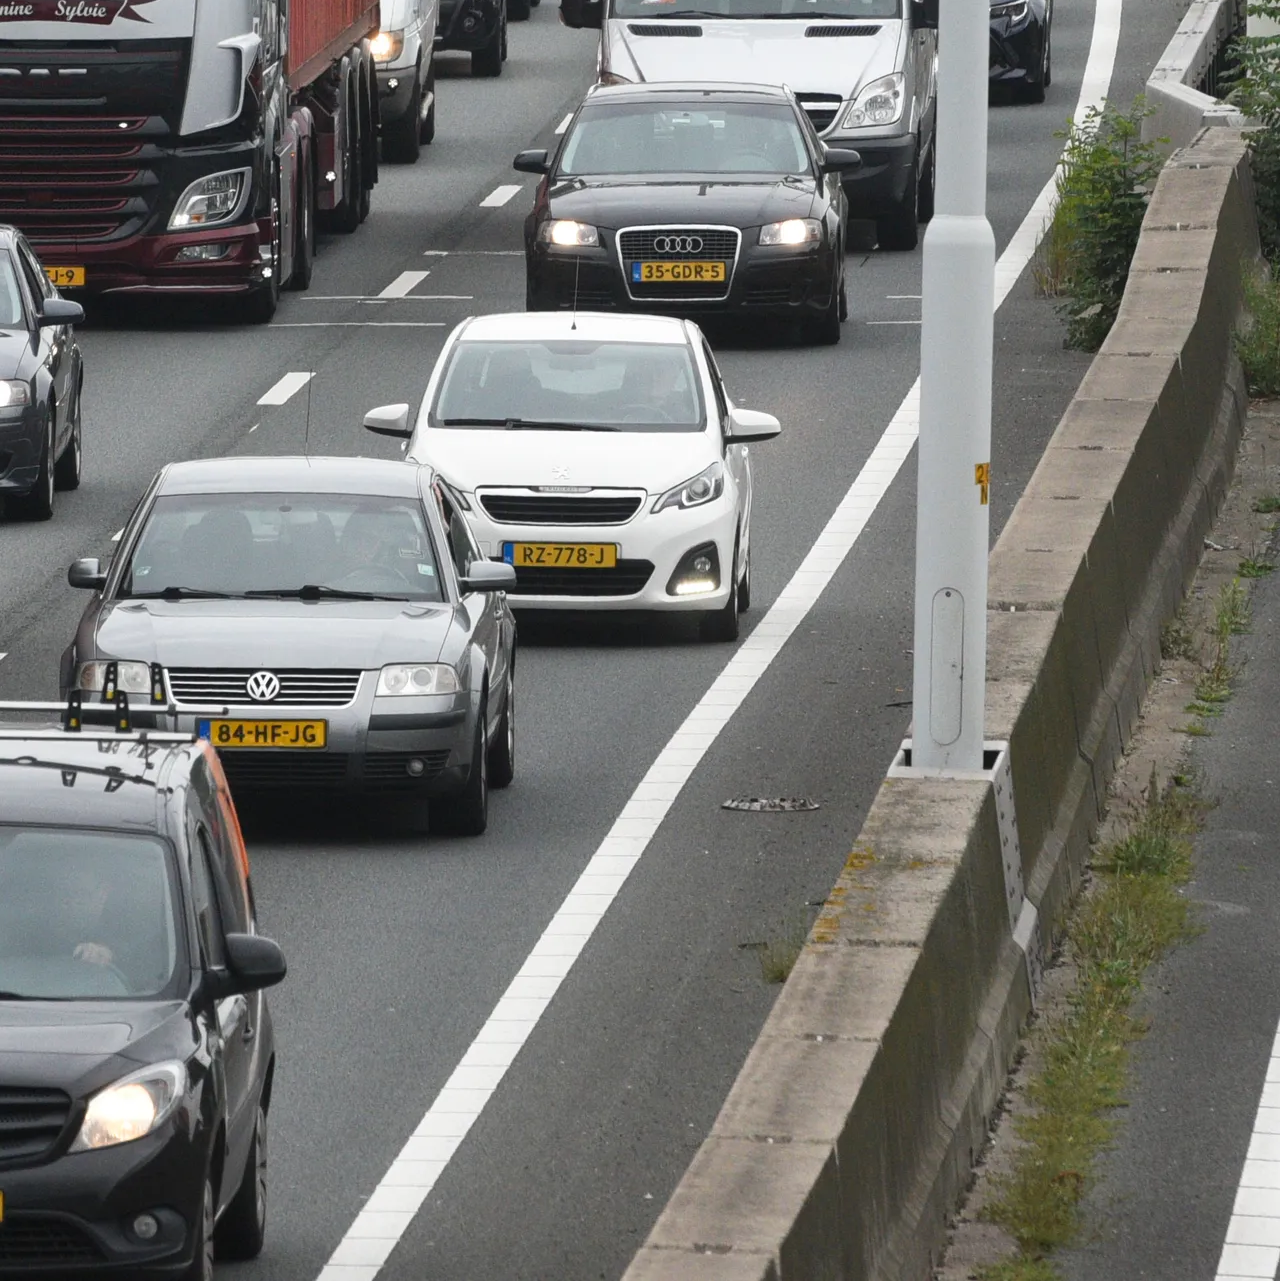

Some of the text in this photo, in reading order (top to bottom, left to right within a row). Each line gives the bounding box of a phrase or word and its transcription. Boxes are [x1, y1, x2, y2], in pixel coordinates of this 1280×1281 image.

[55, 0, 108, 22] Sylvie
[644, 263, 721, 281] 35-GDR-5
[522, 547, 605, 565] RZ-778-J
[217, 724, 317, 744] 84-HF-JG
